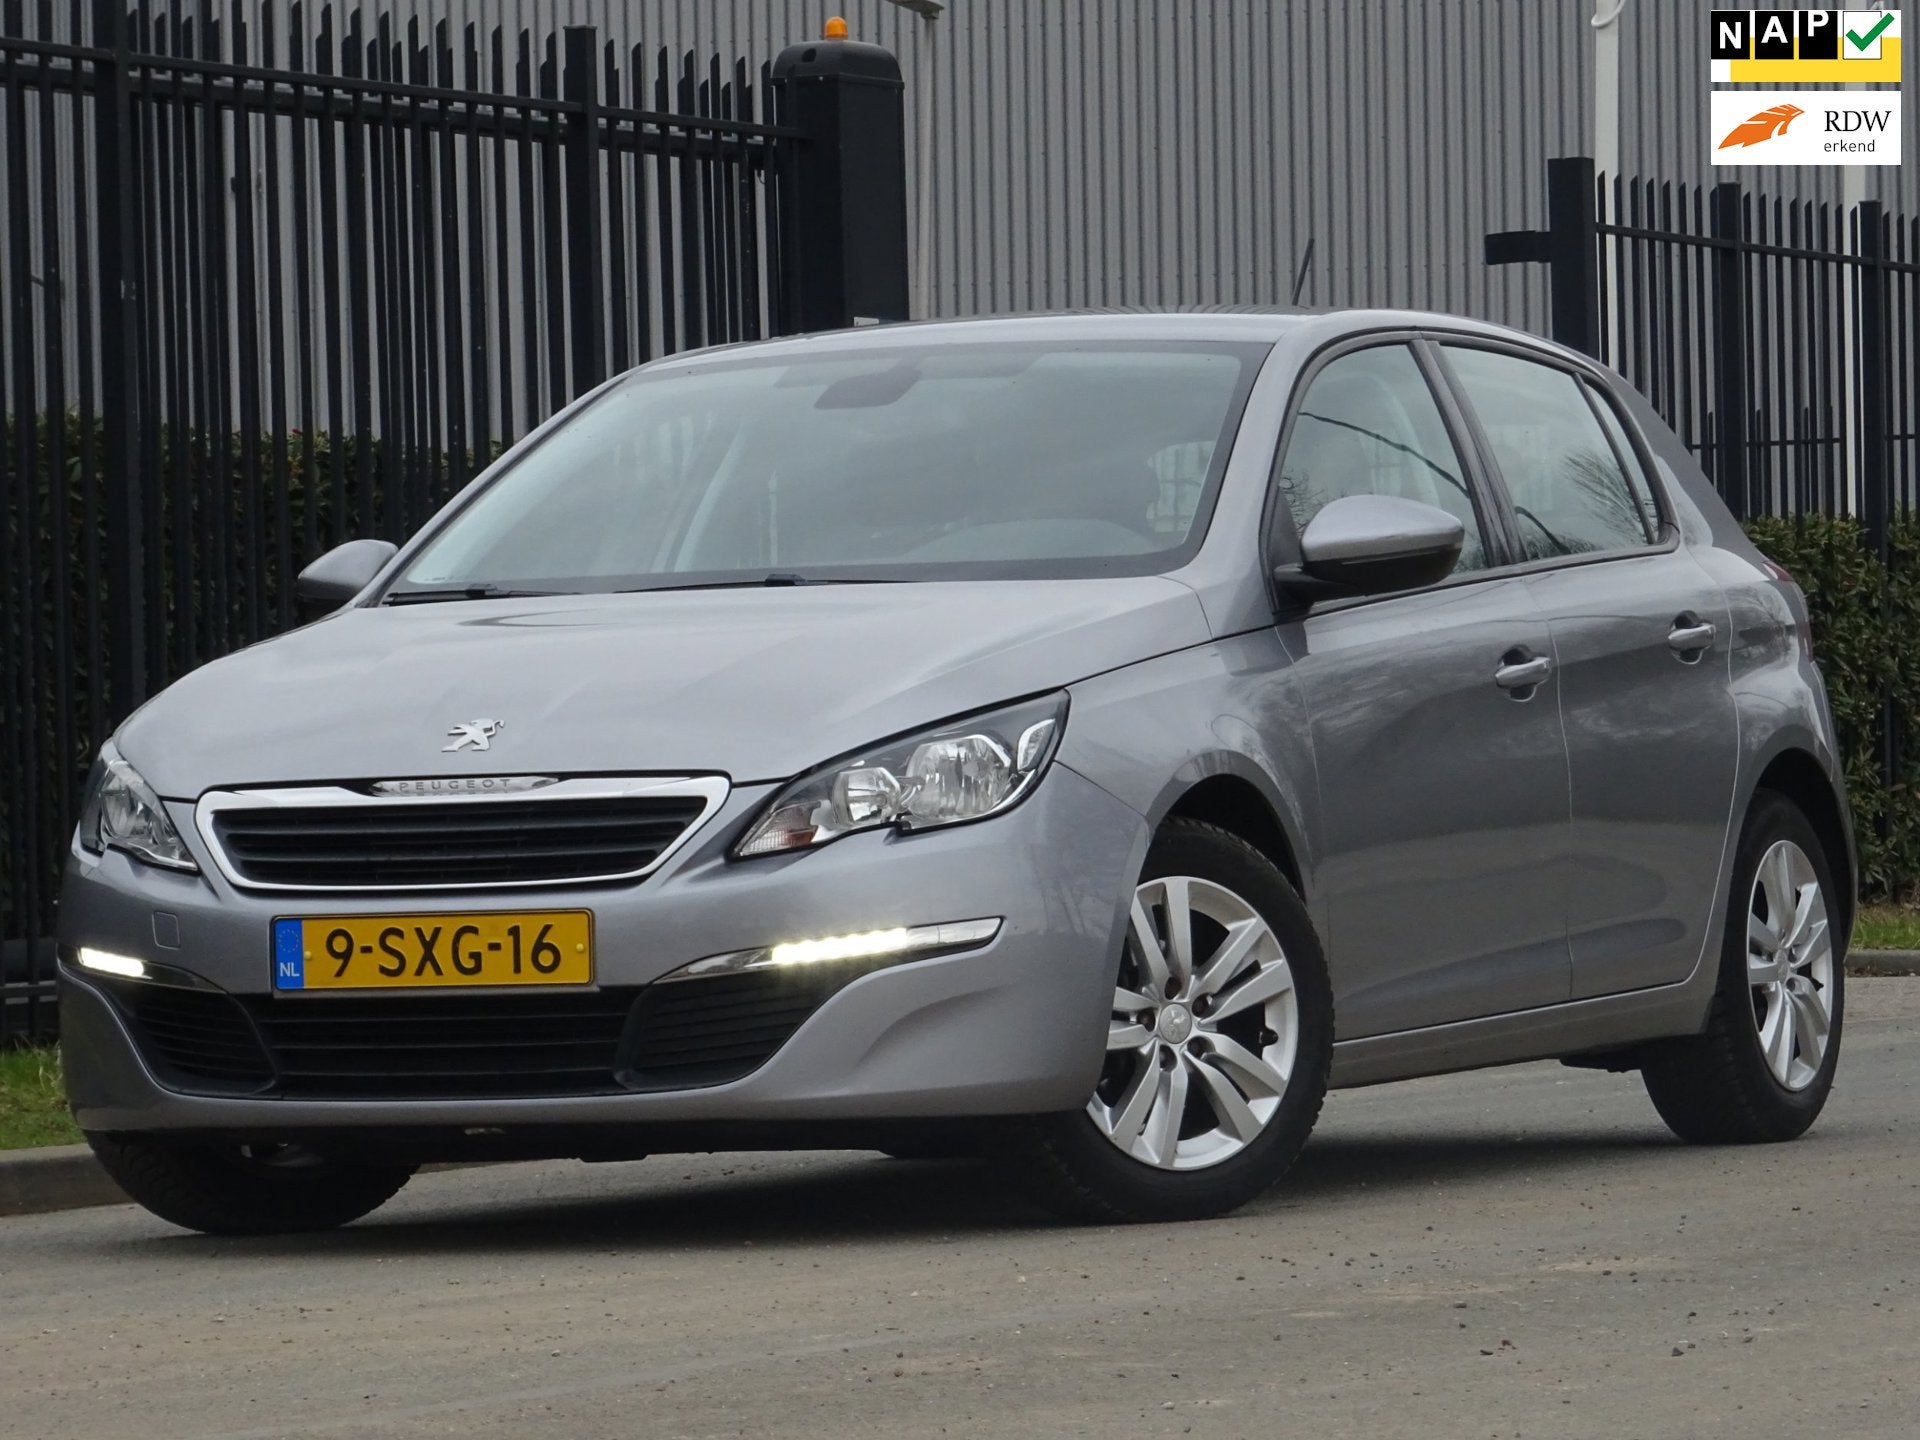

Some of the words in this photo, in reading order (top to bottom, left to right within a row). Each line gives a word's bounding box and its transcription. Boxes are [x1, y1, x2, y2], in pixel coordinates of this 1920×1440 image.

[399, 778, 511, 791] PEUGEOT
[325, 923, 562, 978] 9-SXG-16
[279, 962, 300, 977] NL
